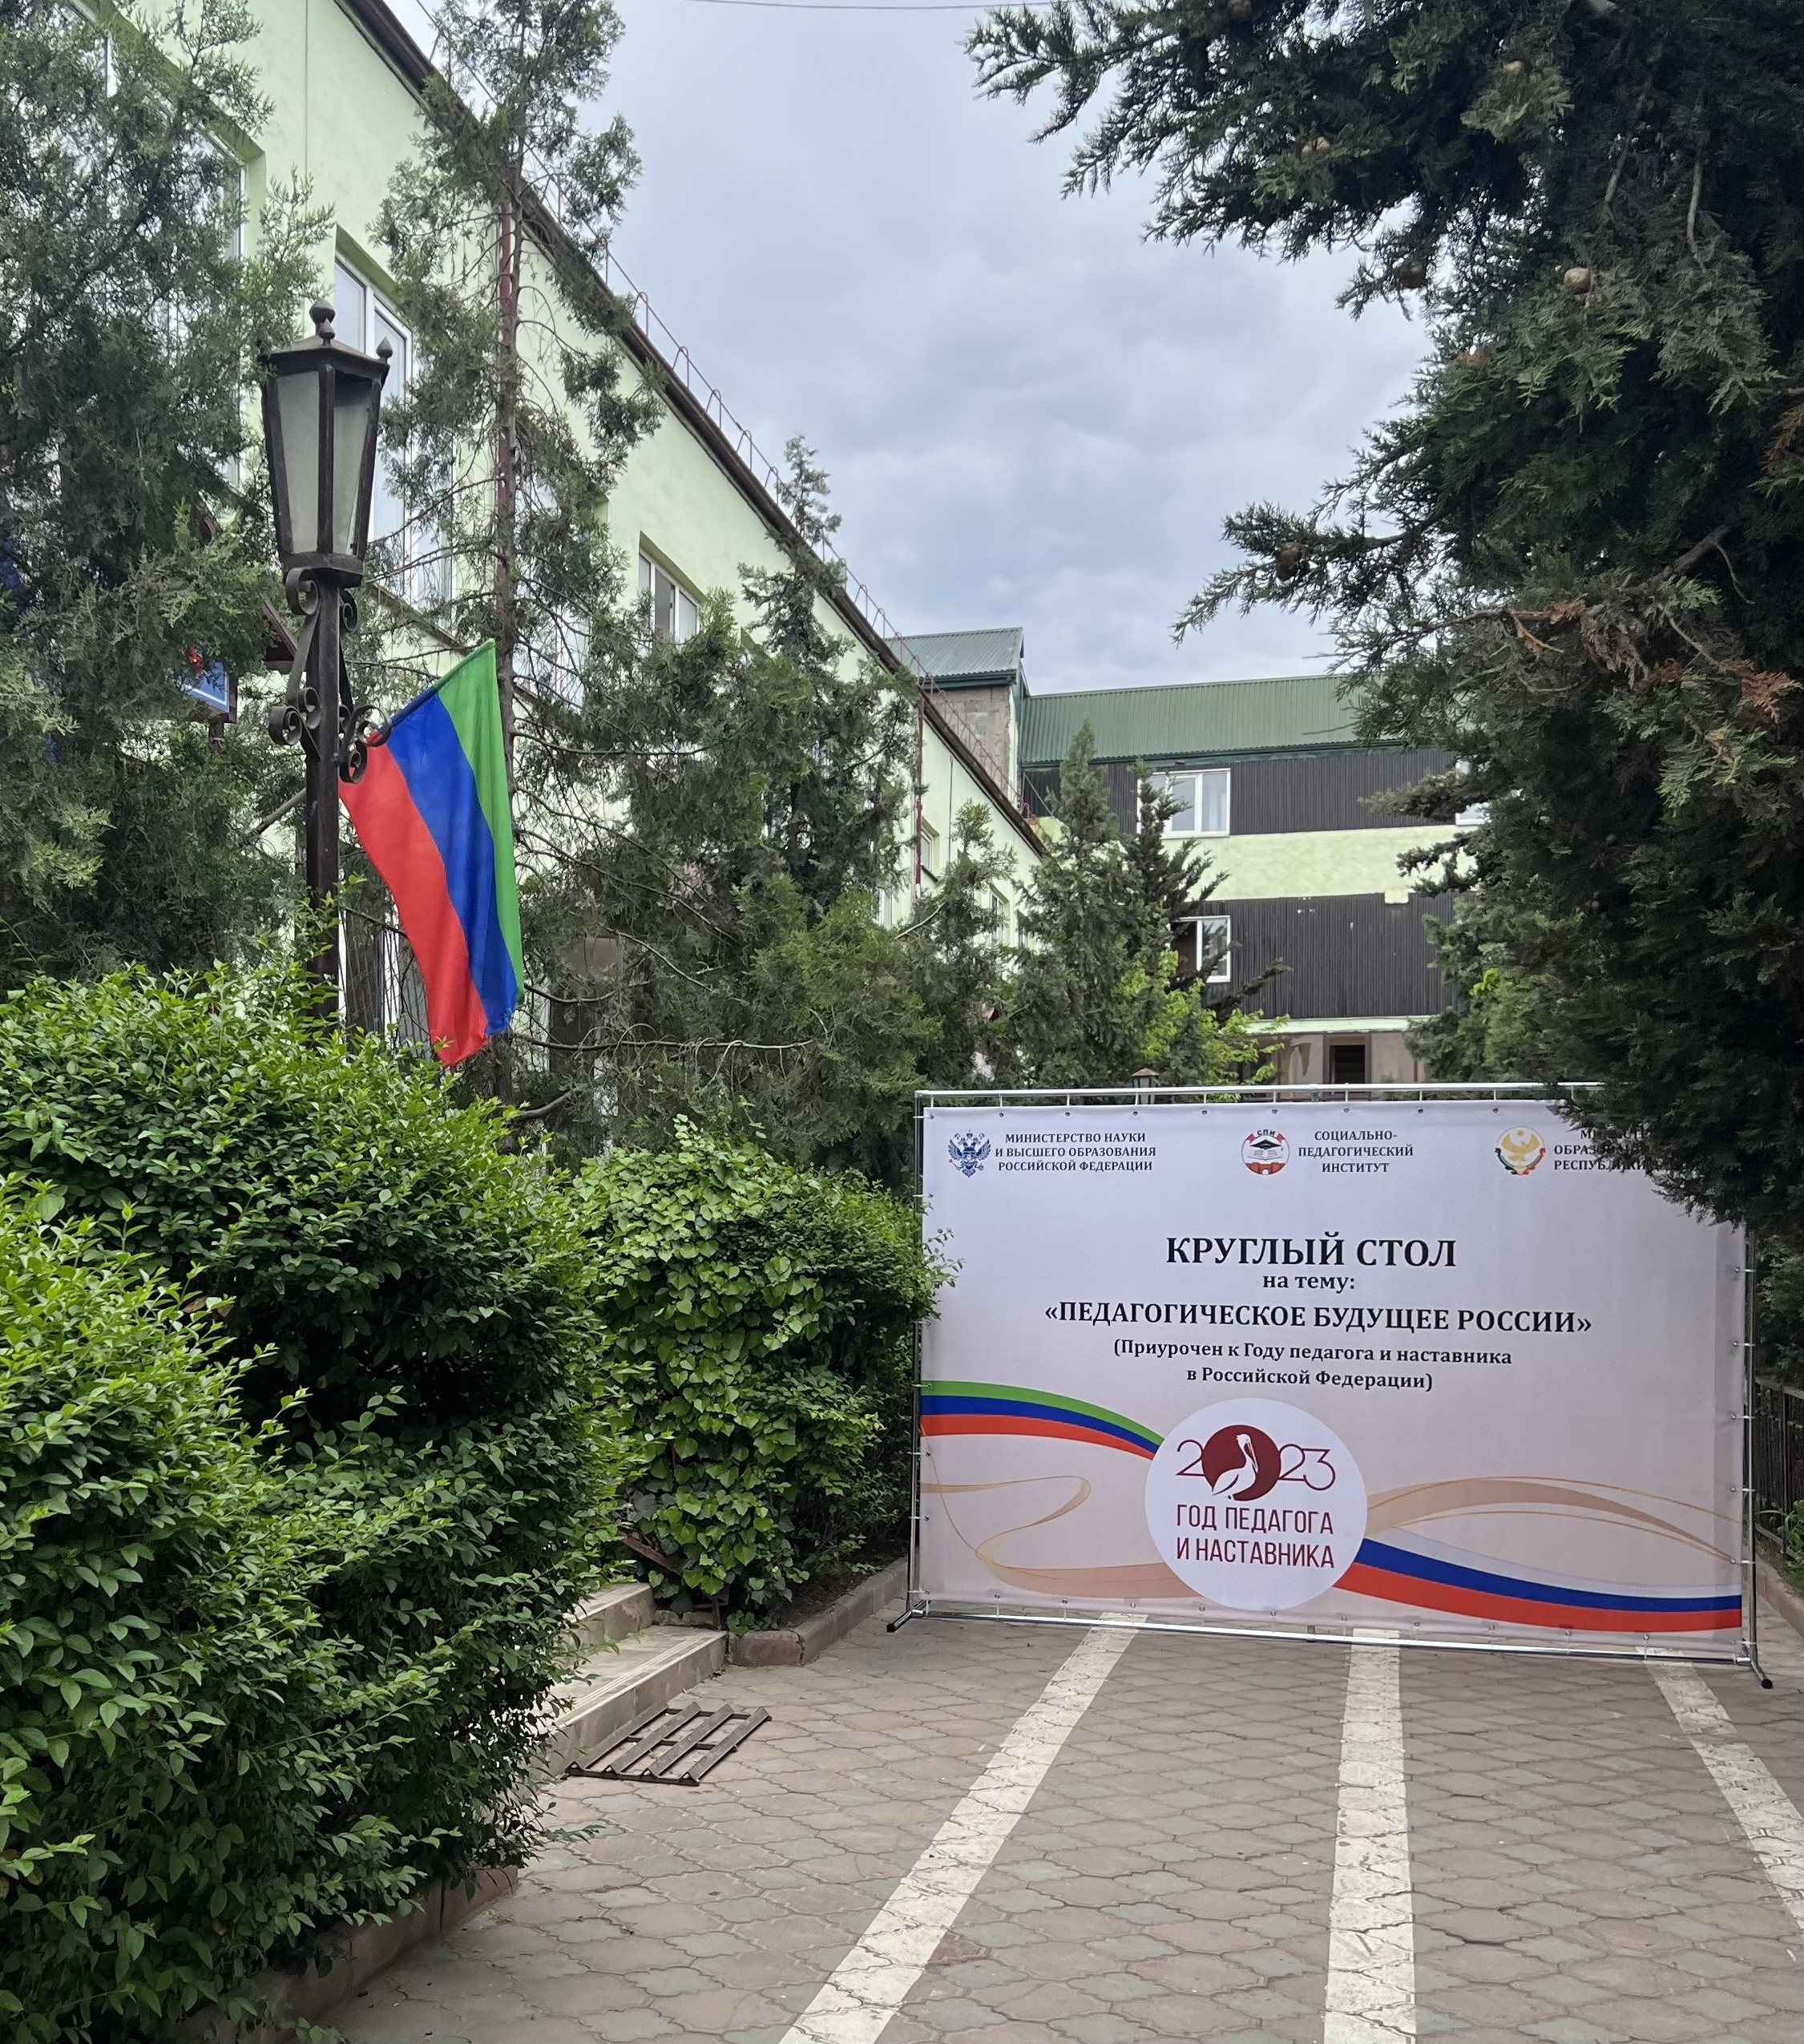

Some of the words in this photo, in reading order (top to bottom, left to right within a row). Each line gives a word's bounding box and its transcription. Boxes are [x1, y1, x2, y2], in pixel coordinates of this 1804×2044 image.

[1005, 1133, 1101, 1143] МИНИСТЕРСТВО
[1104, 1133, 1145, 1142] НАУКИ
[1314, 1130, 1398, 1141] СОЦИАЛЬНО-
[995, 1148, 1003, 1157] И
[1006, 1148, 1066, 1157] ВЫСШЕГО
[1068, 1147, 1156, 1157] ОБРАЗОВАНИЯ
[1298, 1144, 1414, 1157] ПЕДАГОГИЧЕСКИЙ
[998, 1159, 1076, 1171] РОССИЙСКОЙ
[1079, 1161, 1152, 1172] ФЕДЕРАЦИИ
[1322, 1162, 1390, 1173] ИНСТИТУТ
[1554, 1160, 1648, 1170] РЕСПУБИ
[1166, 1231, 1345, 1265] КРУГЛЫЙ
[1356, 1239, 1456, 1266] СТОЛ
[1262, 1275, 1289, 1289] на
[1294, 1275, 1354, 1294] тему:
[1045, 1302, 1306, 1327] «ПЕДАГОГИЧЕСКОЕ
[1314, 1307, 1450, 1334] БУДУЩЕЕ
[1457, 1309, 1592, 1333] РОССИИ»
[1114, 1339, 1223, 1359] (Приурочен
[1228, 1344, 1240, 1356] к
[1244, 1343, 1285, 1362] Году
[1289, 1347, 1374, 1361] педагога
[1379, 1349, 1392, 1361] и
[1397, 1349, 1512, 1364] наставника
[1187, 1369, 1197, 1381] в
[1202, 1367, 1310, 1385] Российской
[1315, 1370, 1433, 1392] Федерации)
[1176, 1504, 1217, 1531] ГОД
[1225, 1507, 1334, 1535] ПЕДАГОГА
[1176, 1537, 1189, 1561] И
[1196, 1538, 1334, 1569] НАСТАВНИКА
